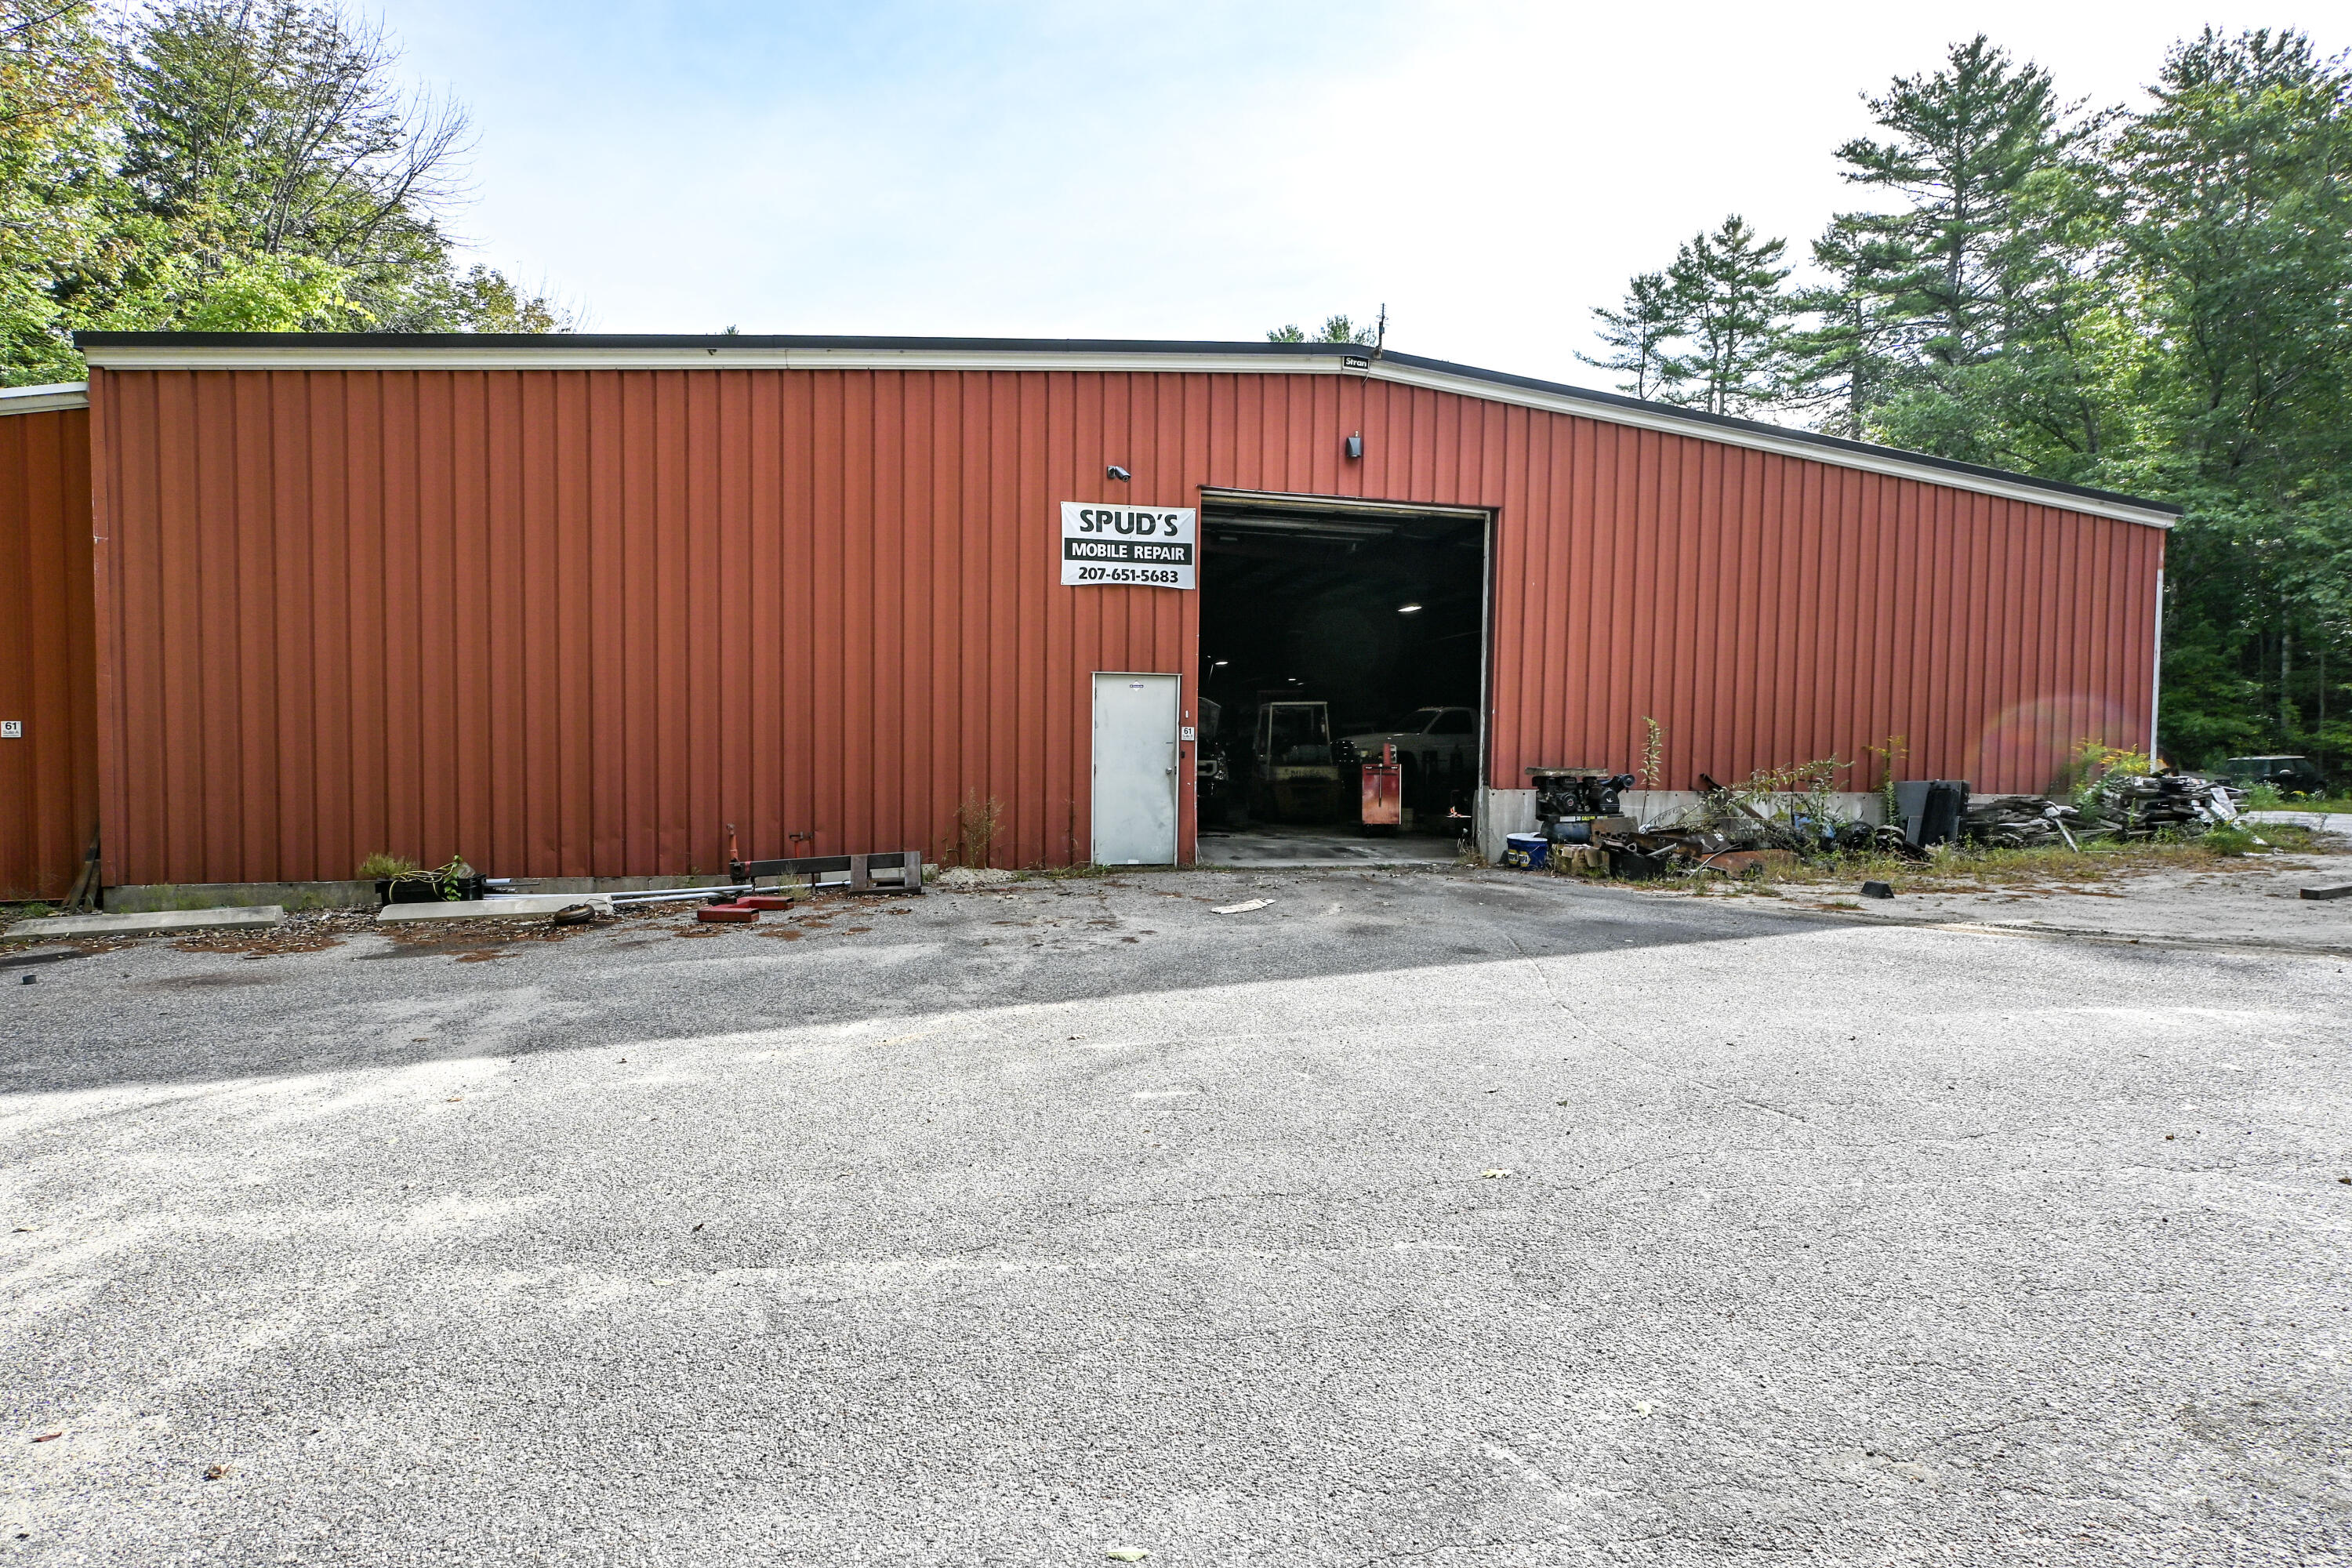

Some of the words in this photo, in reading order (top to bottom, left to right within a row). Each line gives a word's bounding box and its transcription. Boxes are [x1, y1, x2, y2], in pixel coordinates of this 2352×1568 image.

[1345, 358, 1367, 367] Stran
[1080, 510, 1178, 536] SPUD'S
[1072, 543, 1128, 558] MOBILE
[1134, 545, 1185, 561] REPAIR
[1079, 567, 1178, 583] 207-651-5683
